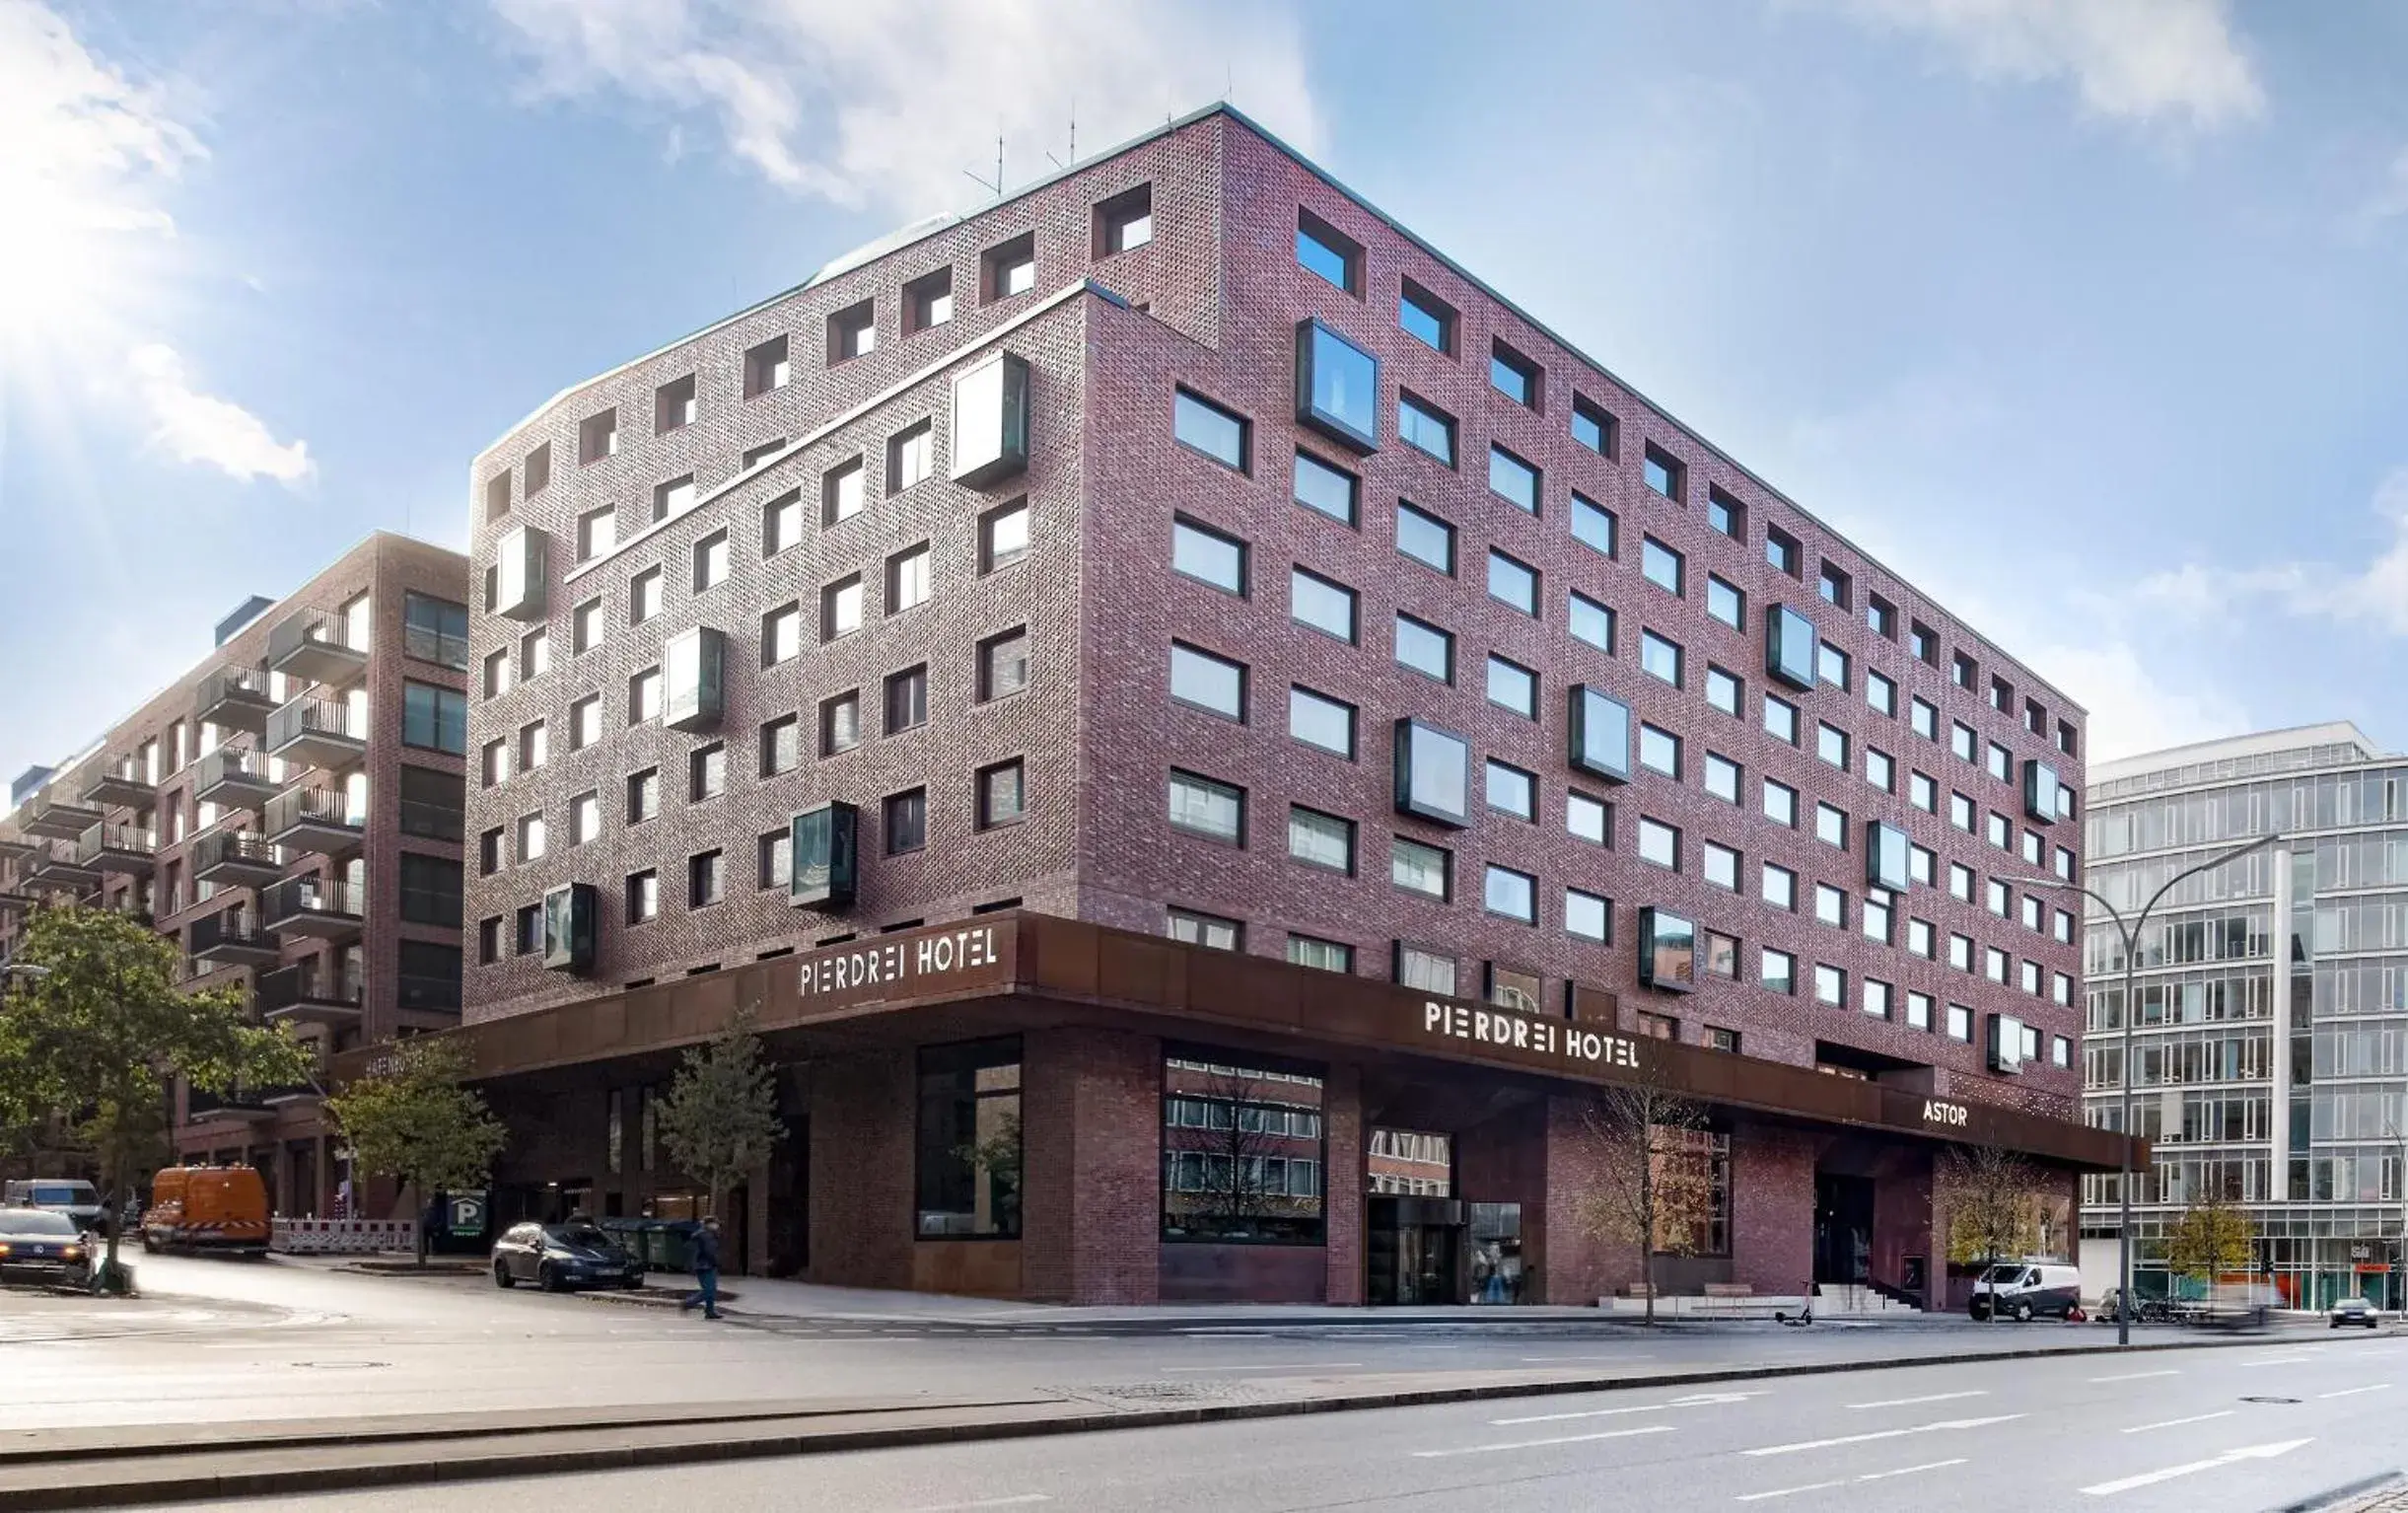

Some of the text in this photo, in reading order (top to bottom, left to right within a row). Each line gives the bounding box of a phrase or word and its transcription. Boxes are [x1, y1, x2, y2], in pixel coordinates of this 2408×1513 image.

[801, 928, 996, 996] PIERDREI HOTEL
[1425, 1001, 1639, 1067] PIERDREI HOTEL
[1923, 1100, 1967, 1126] ASTOR
[458, 1203, 477, 1224] P
